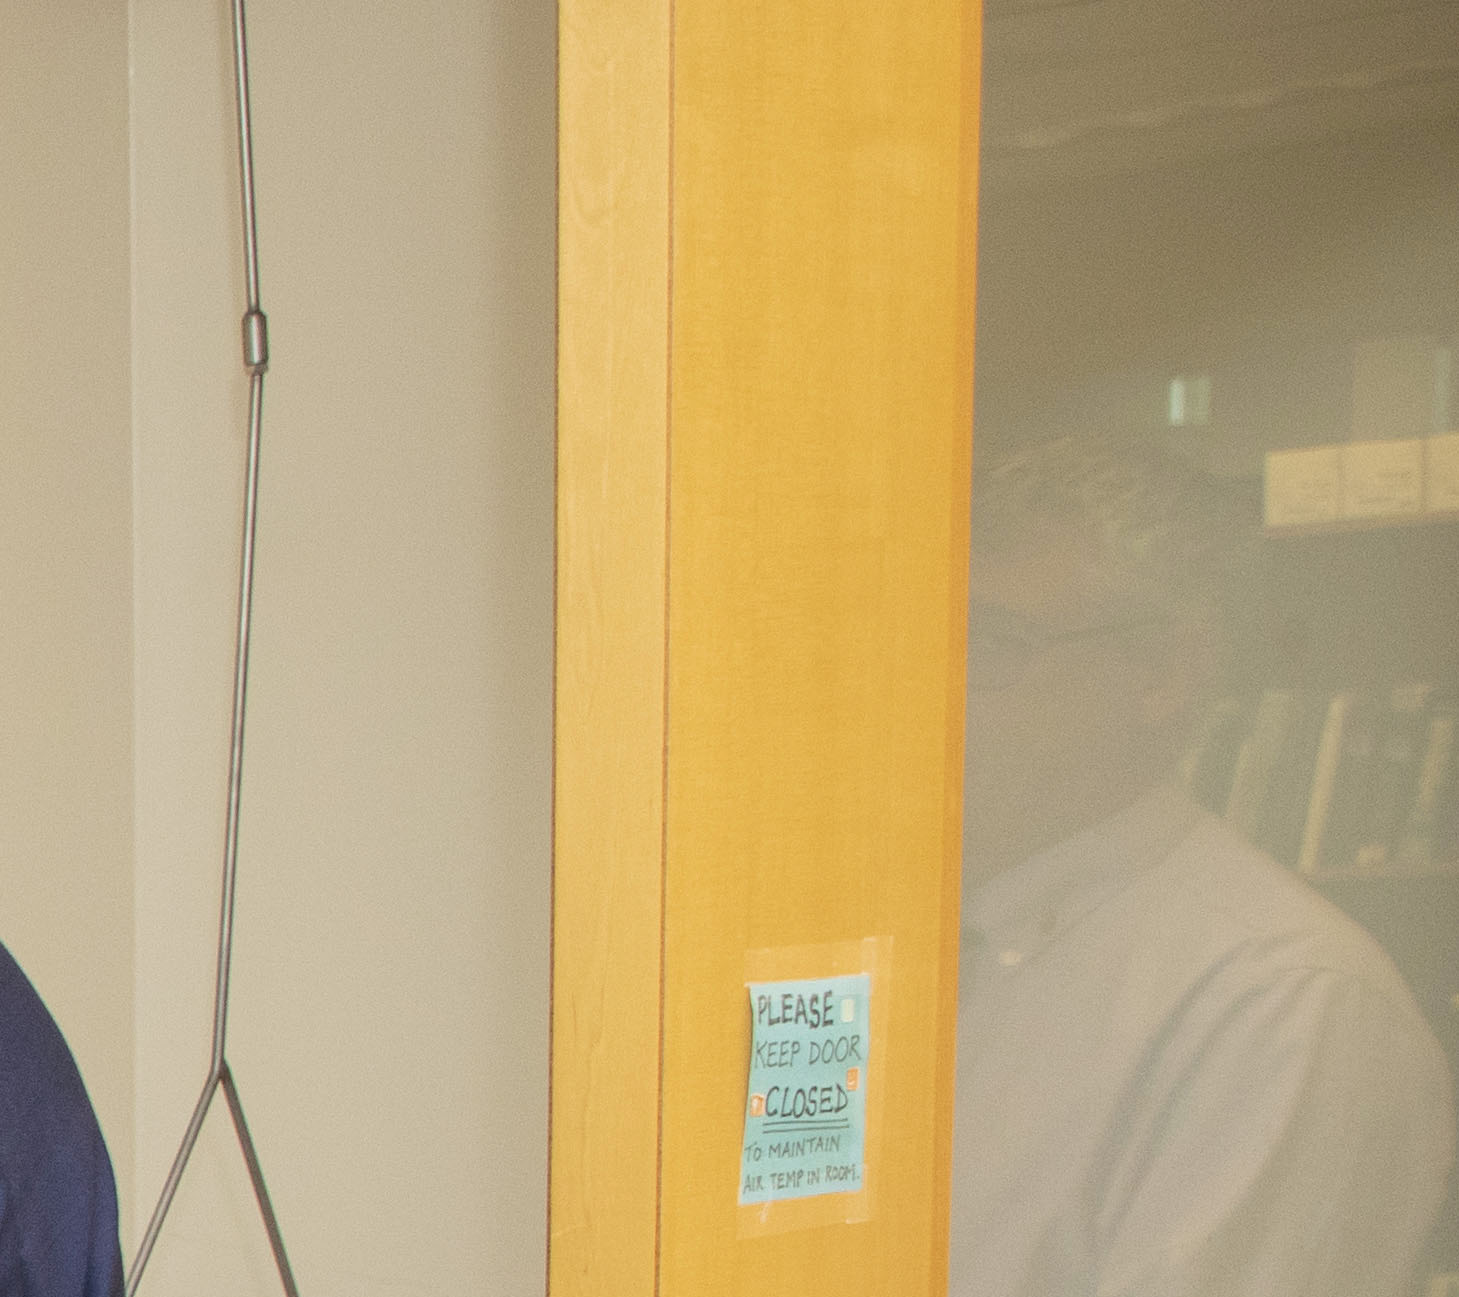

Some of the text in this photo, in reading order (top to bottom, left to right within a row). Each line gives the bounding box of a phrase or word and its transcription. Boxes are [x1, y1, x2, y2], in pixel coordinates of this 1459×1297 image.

[757, 990, 834, 1029] PLEASE
[754, 1034, 862, 1069] KEEP DOOR
[765, 1083, 849, 1118] CLOSED
[743, 1135, 841, 1162] TO MAINTAIN
[742, 1173, 764, 1194] AIR
[769, 1168, 804, 1190] TEMP
[807, 1168, 821, 1185] IN
